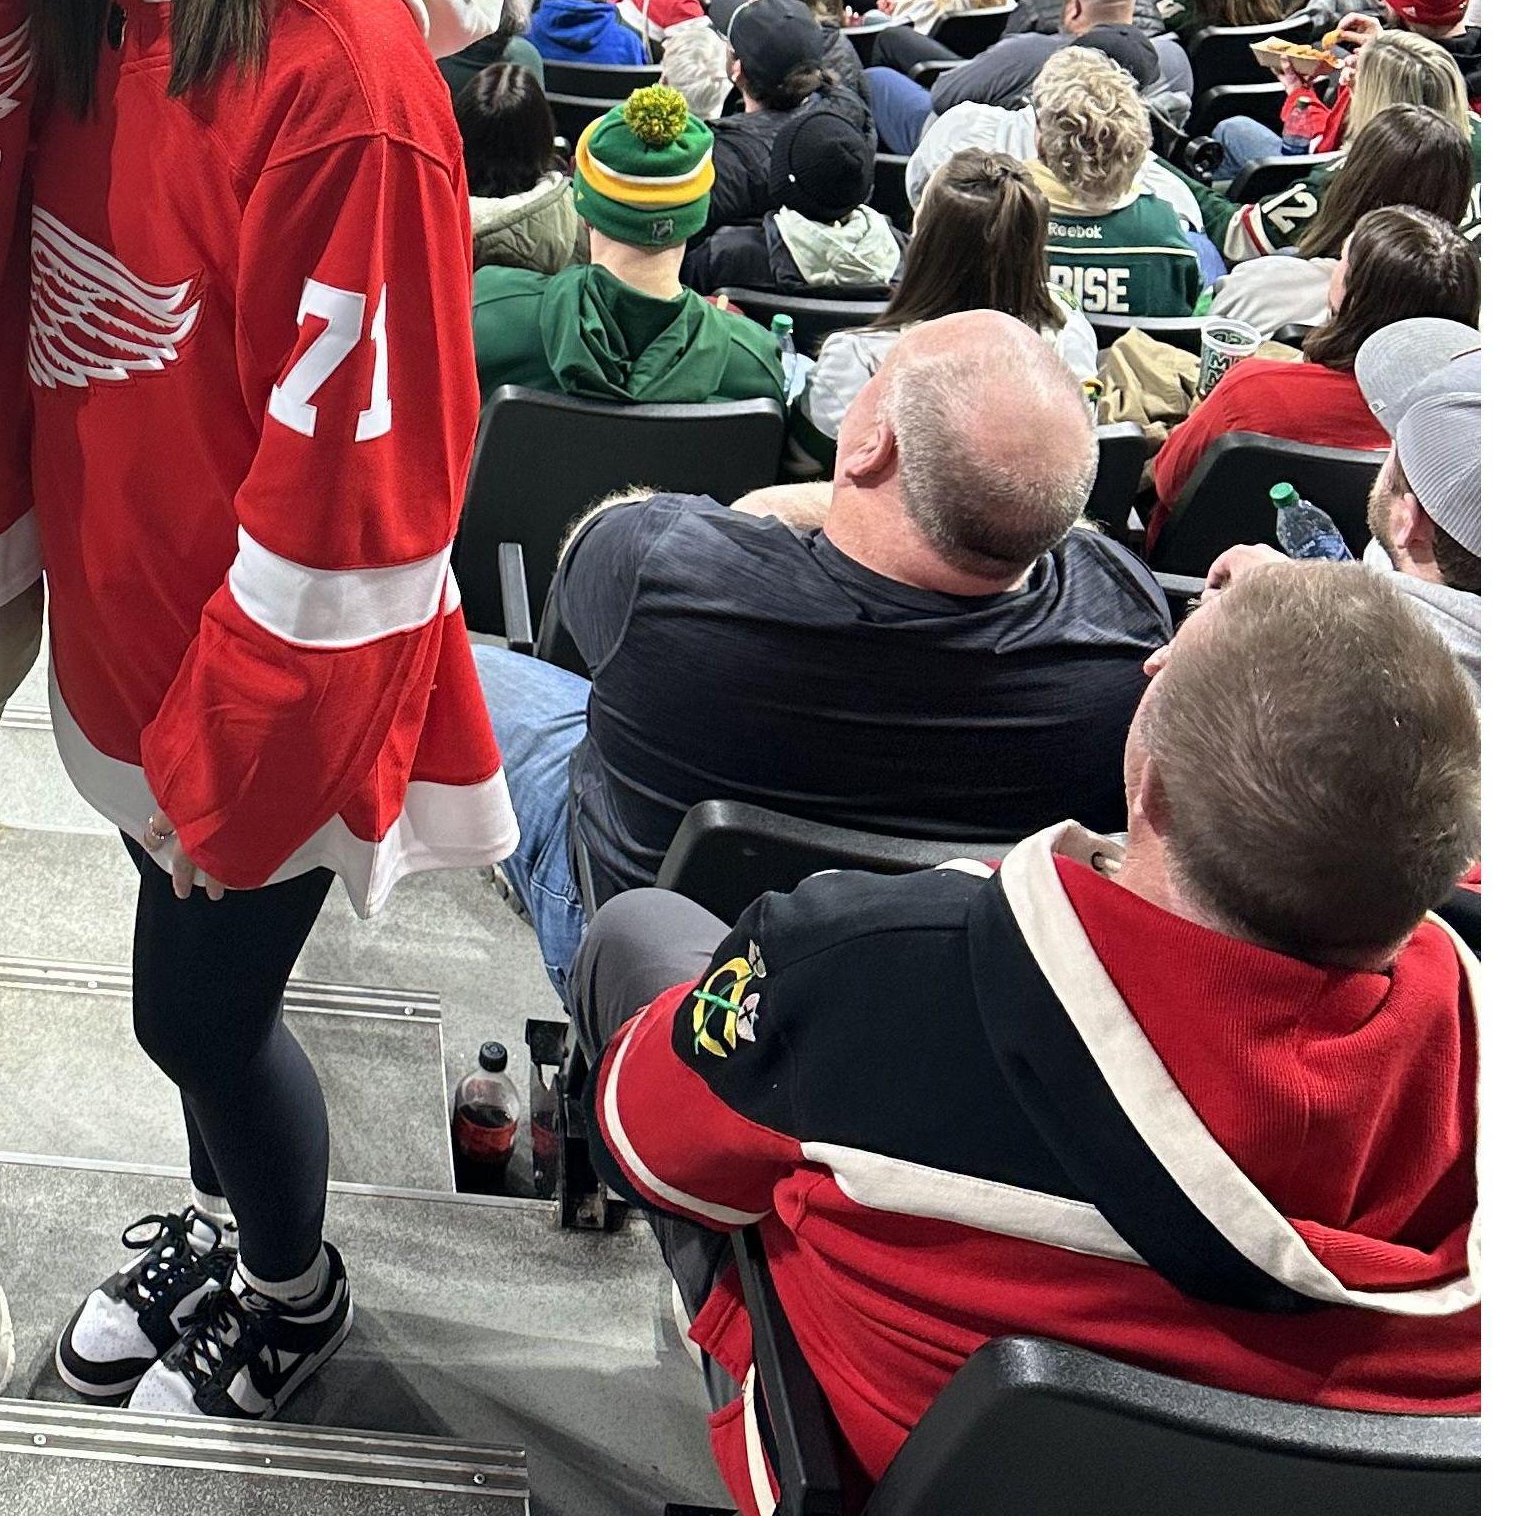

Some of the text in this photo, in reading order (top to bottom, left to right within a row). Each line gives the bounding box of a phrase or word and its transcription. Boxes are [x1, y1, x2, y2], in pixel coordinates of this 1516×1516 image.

[1047, 221, 1103, 239] Reebok
[1261, 183, 1318, 235] 12
[1049, 265, 1130, 313] RISE
[268, 277, 393, 443] 71
